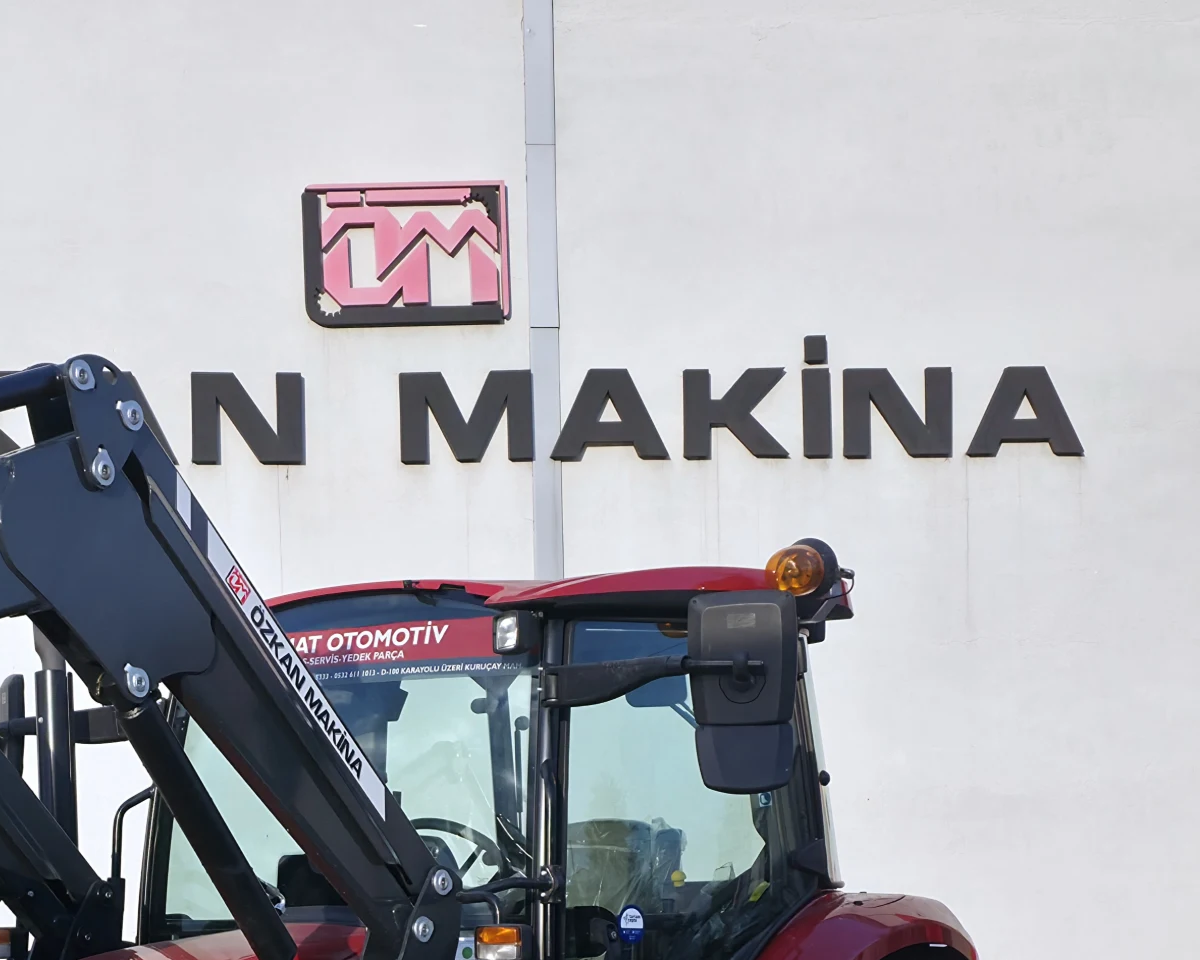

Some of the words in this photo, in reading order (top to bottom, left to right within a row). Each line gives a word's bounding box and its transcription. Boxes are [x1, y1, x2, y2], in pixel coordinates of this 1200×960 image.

[399, 334, 1086, 462] MAKİNA
[289, 633, 322, 654] AT
[326, 621, 449, 652] OTOMOTİV
[373, 649, 404, 661] PARÇA
[400, 664, 440, 675] KARAYOLU
[441, 662, 464, 672] ÜZERİ
[464, 662, 503, 672] KURUÇAY
[250, 604, 305, 692] ÖZKAN
[305, 686, 364, 780] MAKİNA
